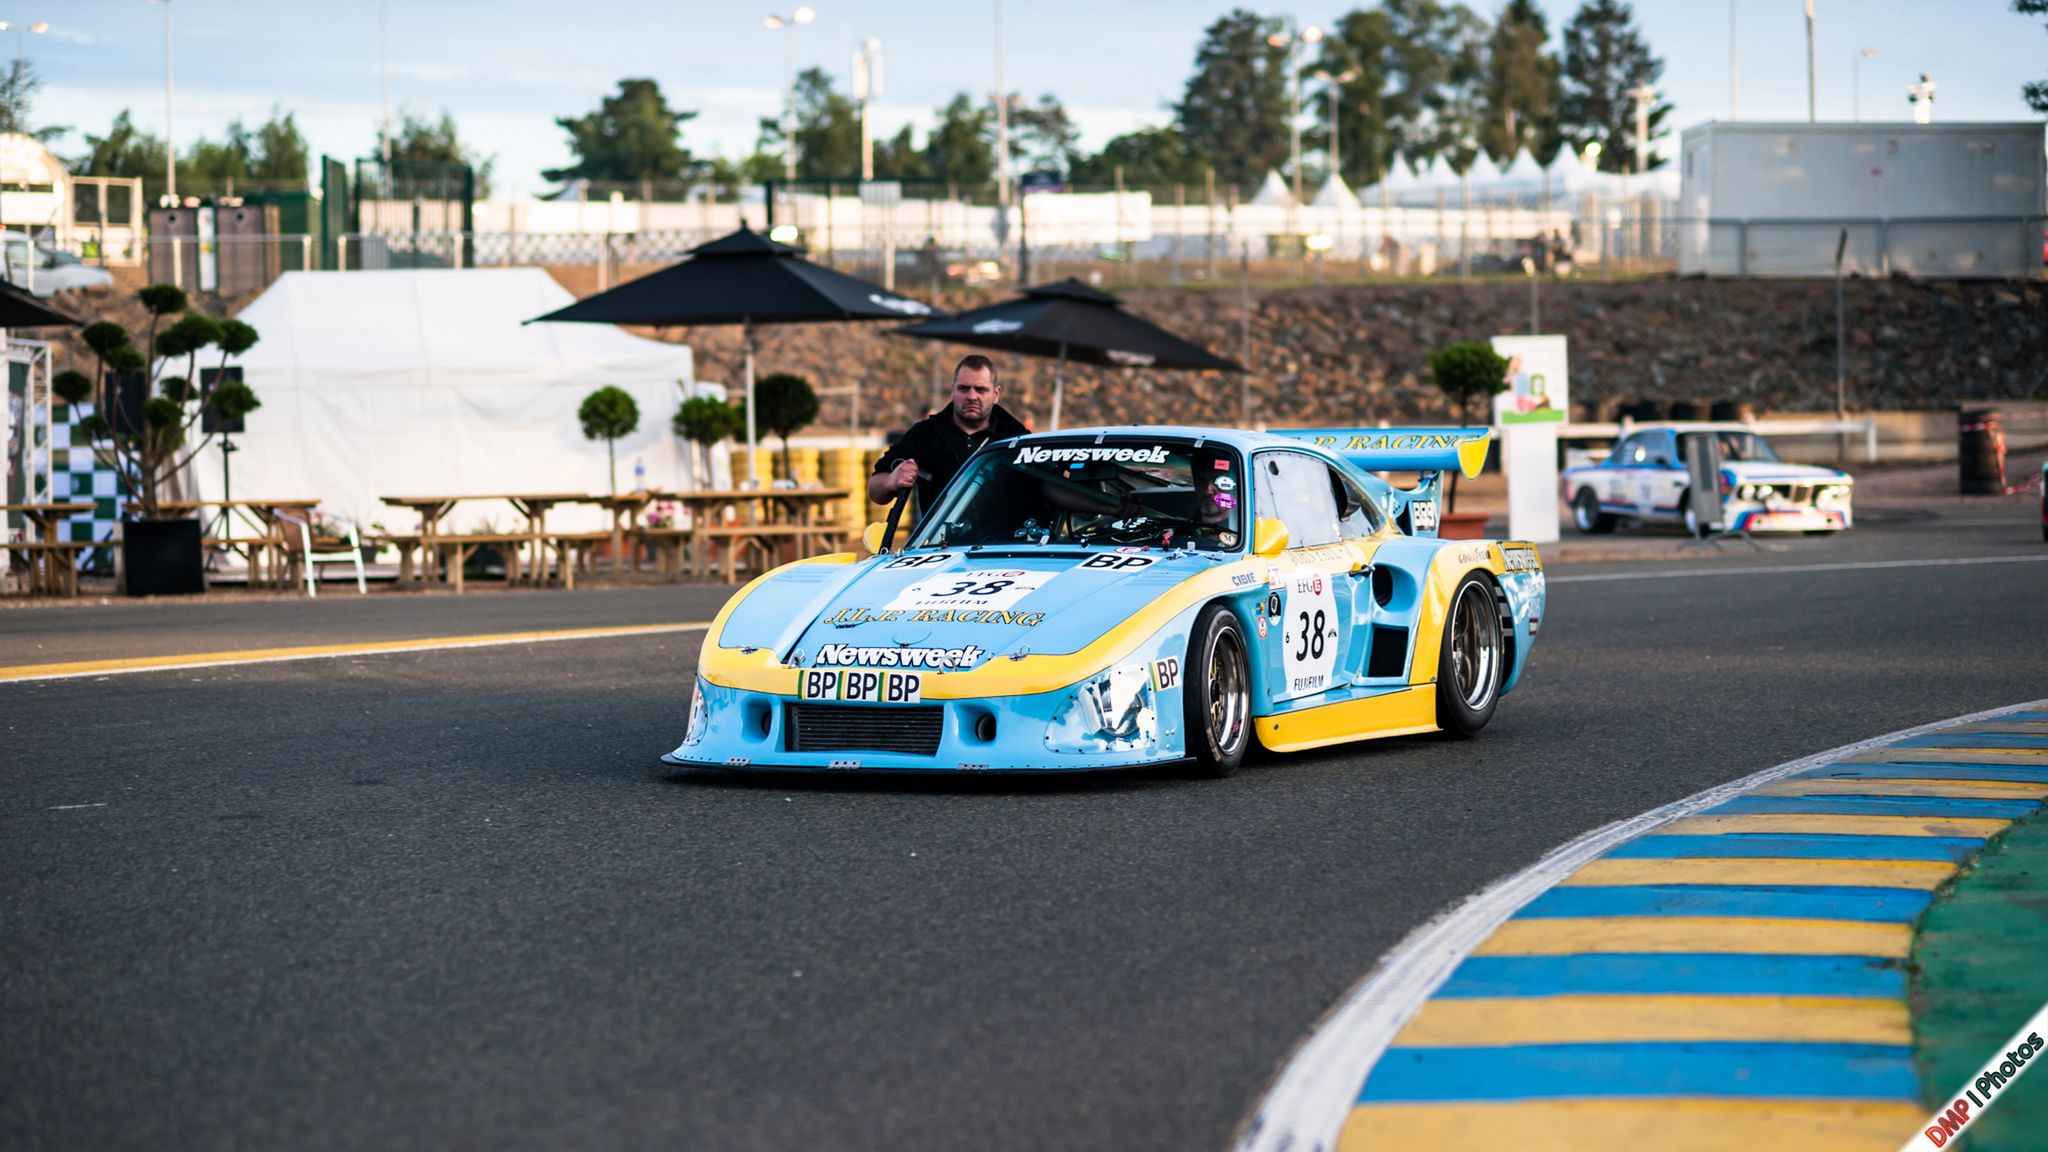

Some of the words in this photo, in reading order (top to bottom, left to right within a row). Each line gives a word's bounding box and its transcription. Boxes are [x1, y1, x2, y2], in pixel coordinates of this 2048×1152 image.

[1013, 446, 1170, 464] Newsweek
[884, 554, 951, 569] BP
[1082, 554, 1152, 570] BP
[931, 580, 1015, 597] 38
[1297, 578, 1313, 594] EFG
[824, 608, 898, 624] J.L.P.
[907, 609, 1045, 627] RACING
[1285, 632, 1290, 644] 6
[1296, 609, 1325, 662] 38
[816, 642, 985, 668] Newsweek
[1156, 658, 1178, 689] BP
[807, 671, 837, 699] BP
[846, 672, 878, 701] BP
[888, 673, 920, 702] BP
[1294, 675, 1324, 691] FUJIFILM
